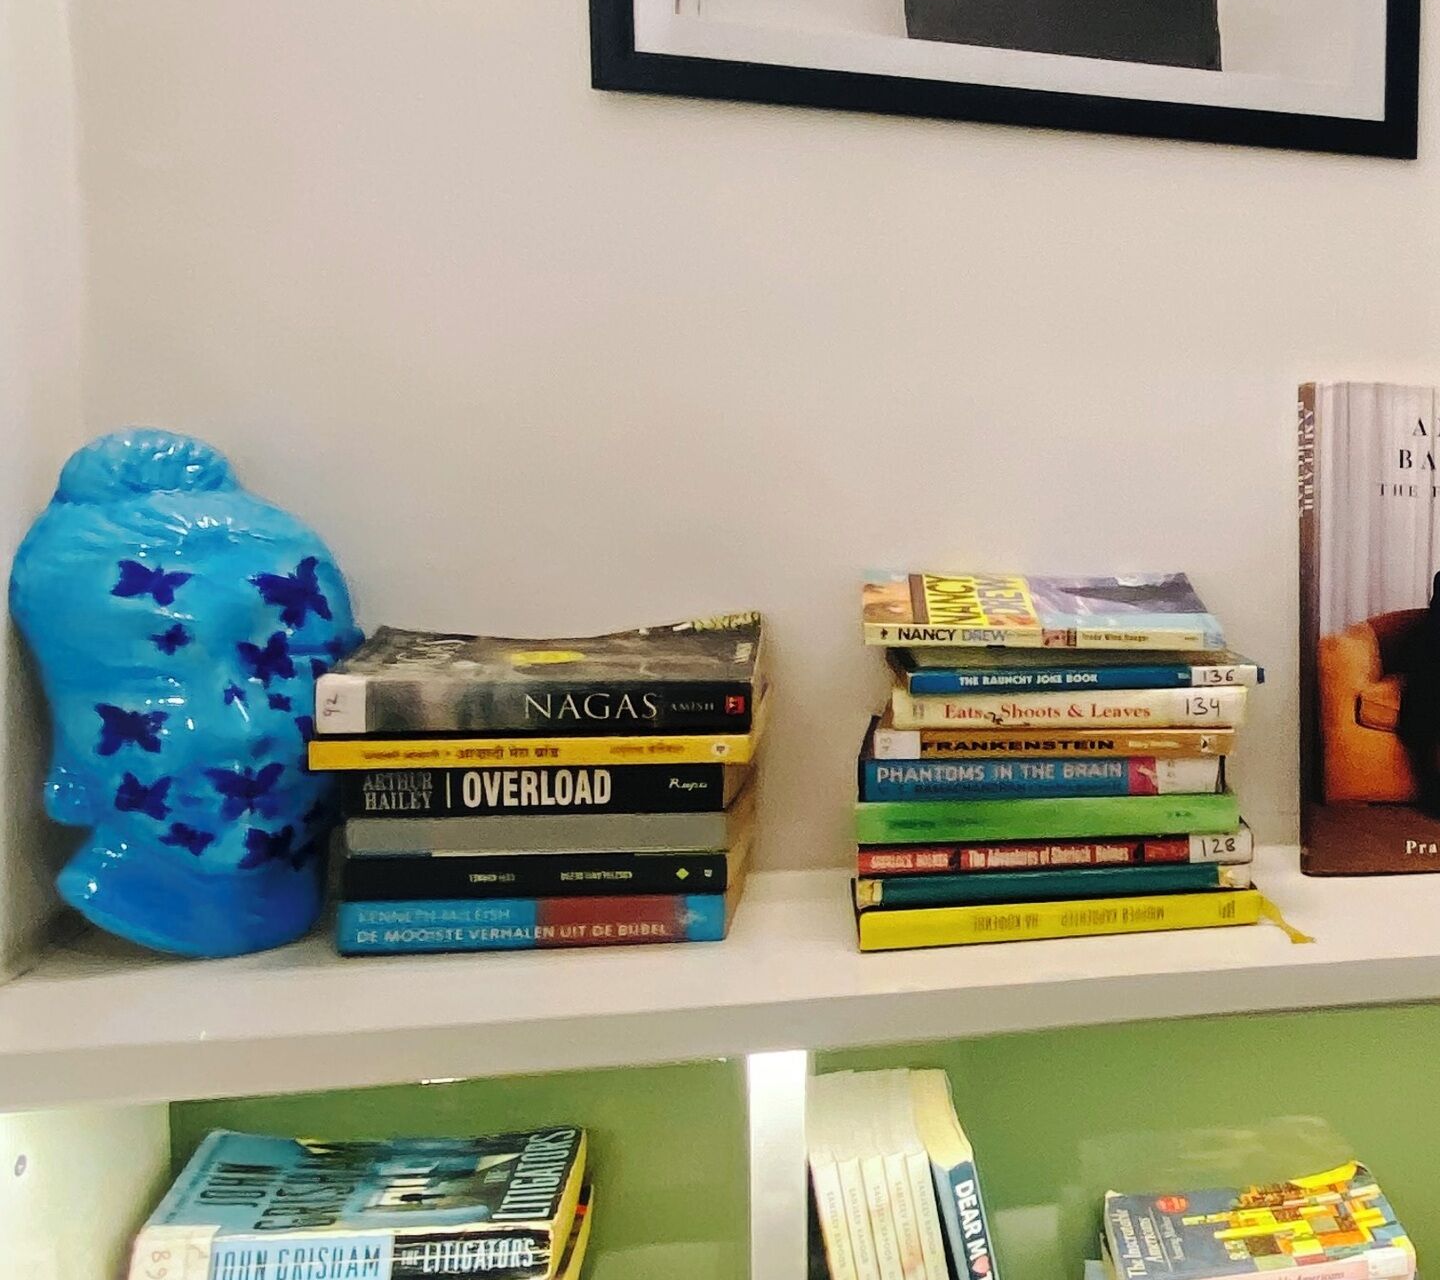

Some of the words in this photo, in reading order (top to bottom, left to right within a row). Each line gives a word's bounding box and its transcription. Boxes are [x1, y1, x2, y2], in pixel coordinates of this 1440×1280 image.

[1379, 482, 1418, 497] THE
[898, 627, 957, 642] NANCY
[962, 628, 1006, 643] DREW
[1066, 673, 1099, 683] BOOK
[1202, 668, 1235, 684] 136
[523, 693, 659, 721] NAGAS
[1001, 701, 1063, 720] Shoots
[1067, 702, 1084, 718] &
[1091, 702, 1151, 720] Leaves
[1185, 696, 1221, 717] 134
[921, 739, 1114, 753] FRANKENSTEIN
[363, 773, 433, 792] ARTHUR
[877, 765, 985, 784] PHANTOMS
[991, 764, 1013, 780] IN
[1020, 763, 1055, 780] THE
[462, 770, 611, 808] OVERLOAD
[365, 790, 433, 811] HAILEY
[1201, 837, 1236, 857] 128
[357, 929, 378, 944] DE
[469, 926, 554, 942] VERHALEN
[560, 925, 587, 940] UIT
[592, 925, 613, 939] DE
[491, 1127, 576, 1221] LITIGATORS
[953, 1179, 983, 1239] DEAR
[276, 1247, 382, 1280] GRISHAM
[422, 1237, 536, 1274] LITIGATORS
